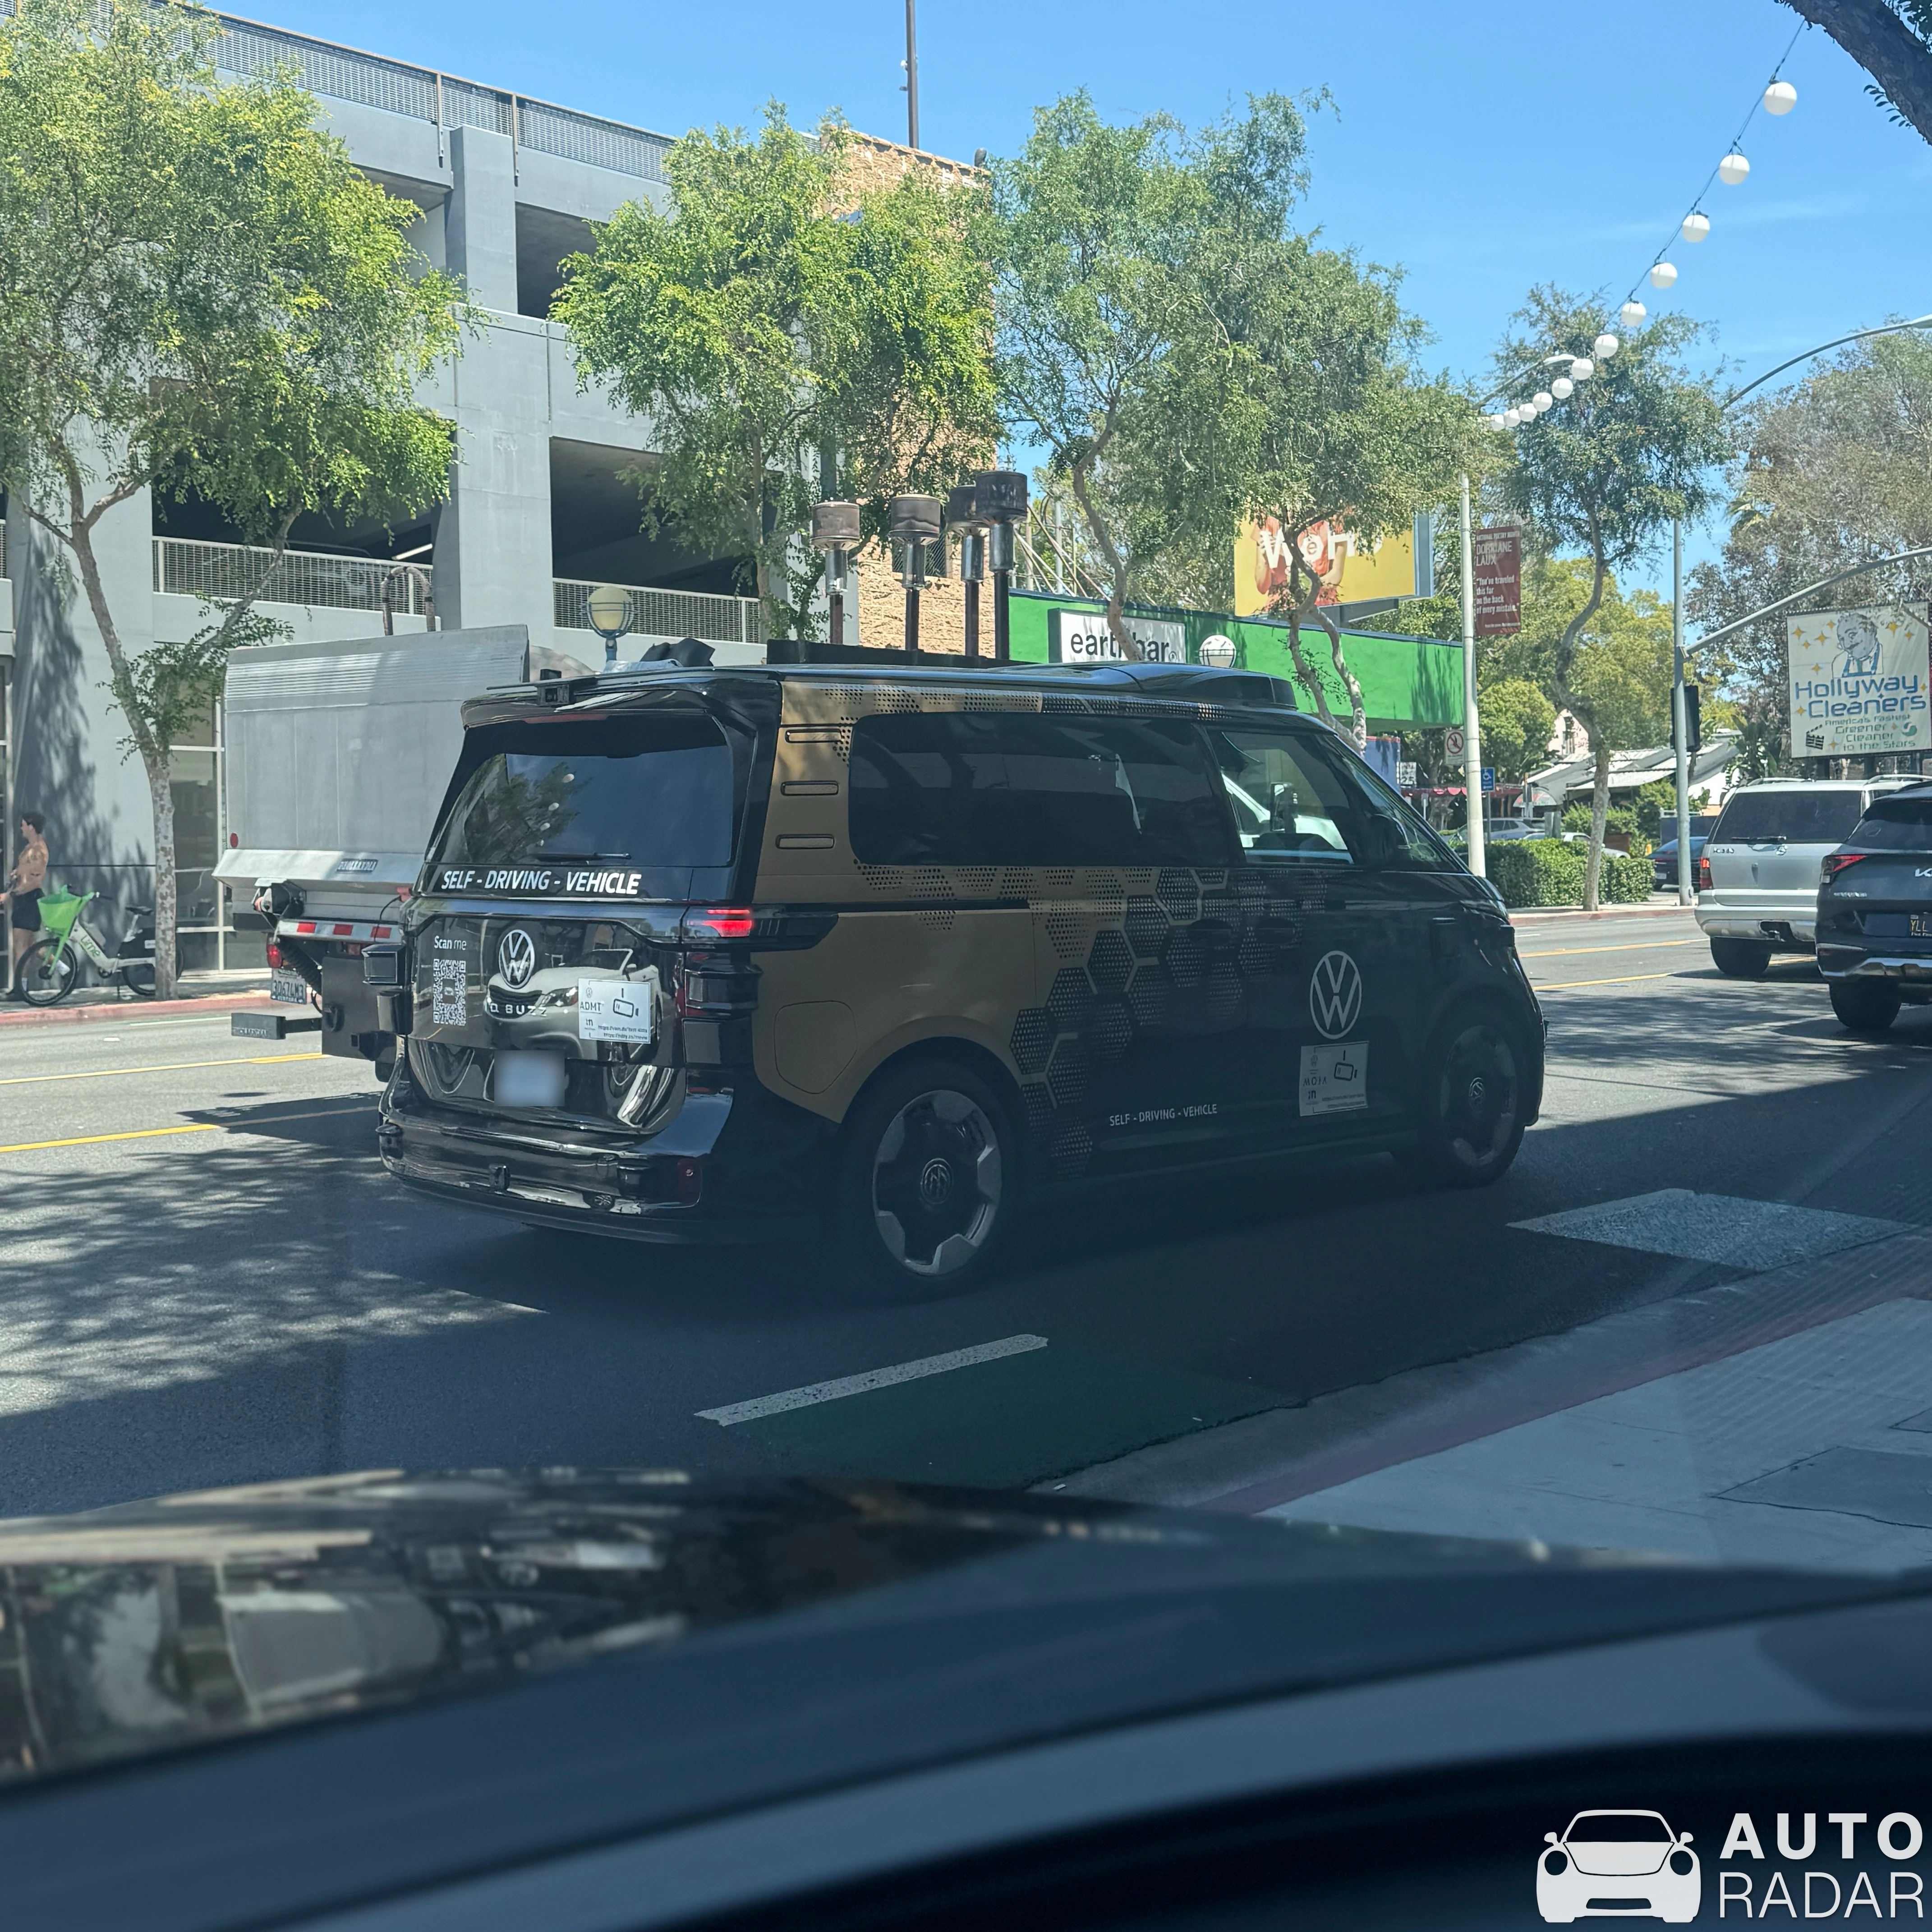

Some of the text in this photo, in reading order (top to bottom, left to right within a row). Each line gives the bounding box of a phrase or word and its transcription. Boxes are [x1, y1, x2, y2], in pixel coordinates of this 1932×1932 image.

[1260, 521, 1383, 569] WeH
[1476, 553, 1497, 566] LAUX
[1795, 675, 1918, 699] Hollyway
[1808, 695, 1926, 718] Cleaners
[1835, 723, 1886, 734] Greener
[1846, 732, 1894, 742] Cleaner
[1860, 742, 1879, 750] the
[1883, 740, 1917, 749] Stars
[1401, 775, 1415, 785] 25
[442, 870, 475, 889] SELF
[485, 871, 552, 890] DRIVING
[566, 872, 642, 894] VEHICLE
[81, 935, 100, 957] Lime
[434, 935, 467, 950] Scan me
[505, 1004, 547, 1017] BUZZ
[580, 1001, 602, 1012] ADMT
[1109, 1113, 1130, 1127] SELF
[1139, 1108, 1175, 1122] DRIVING
[1183, 1104, 1218, 1118] VEHICLE
